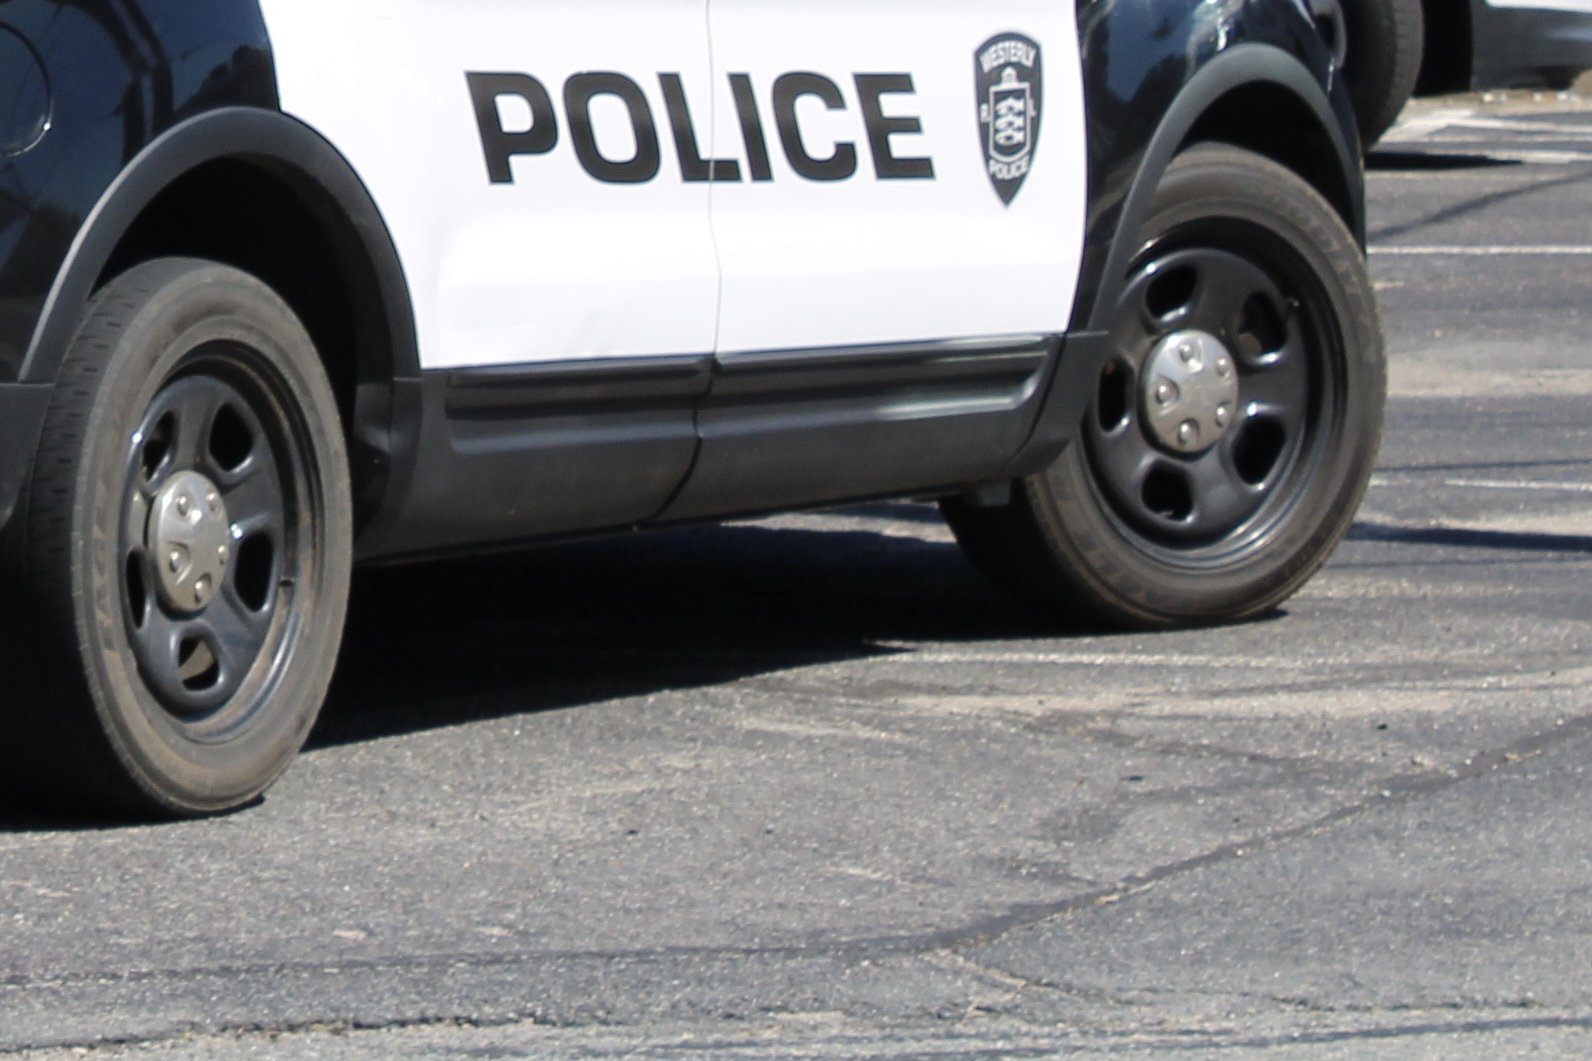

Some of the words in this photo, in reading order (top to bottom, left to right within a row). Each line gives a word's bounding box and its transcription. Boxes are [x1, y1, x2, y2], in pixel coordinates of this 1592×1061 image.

[979, 40, 1037, 74] WESTERLY
[464, 70, 936, 184] POLICE
[988, 155, 1030, 181] POLICE
